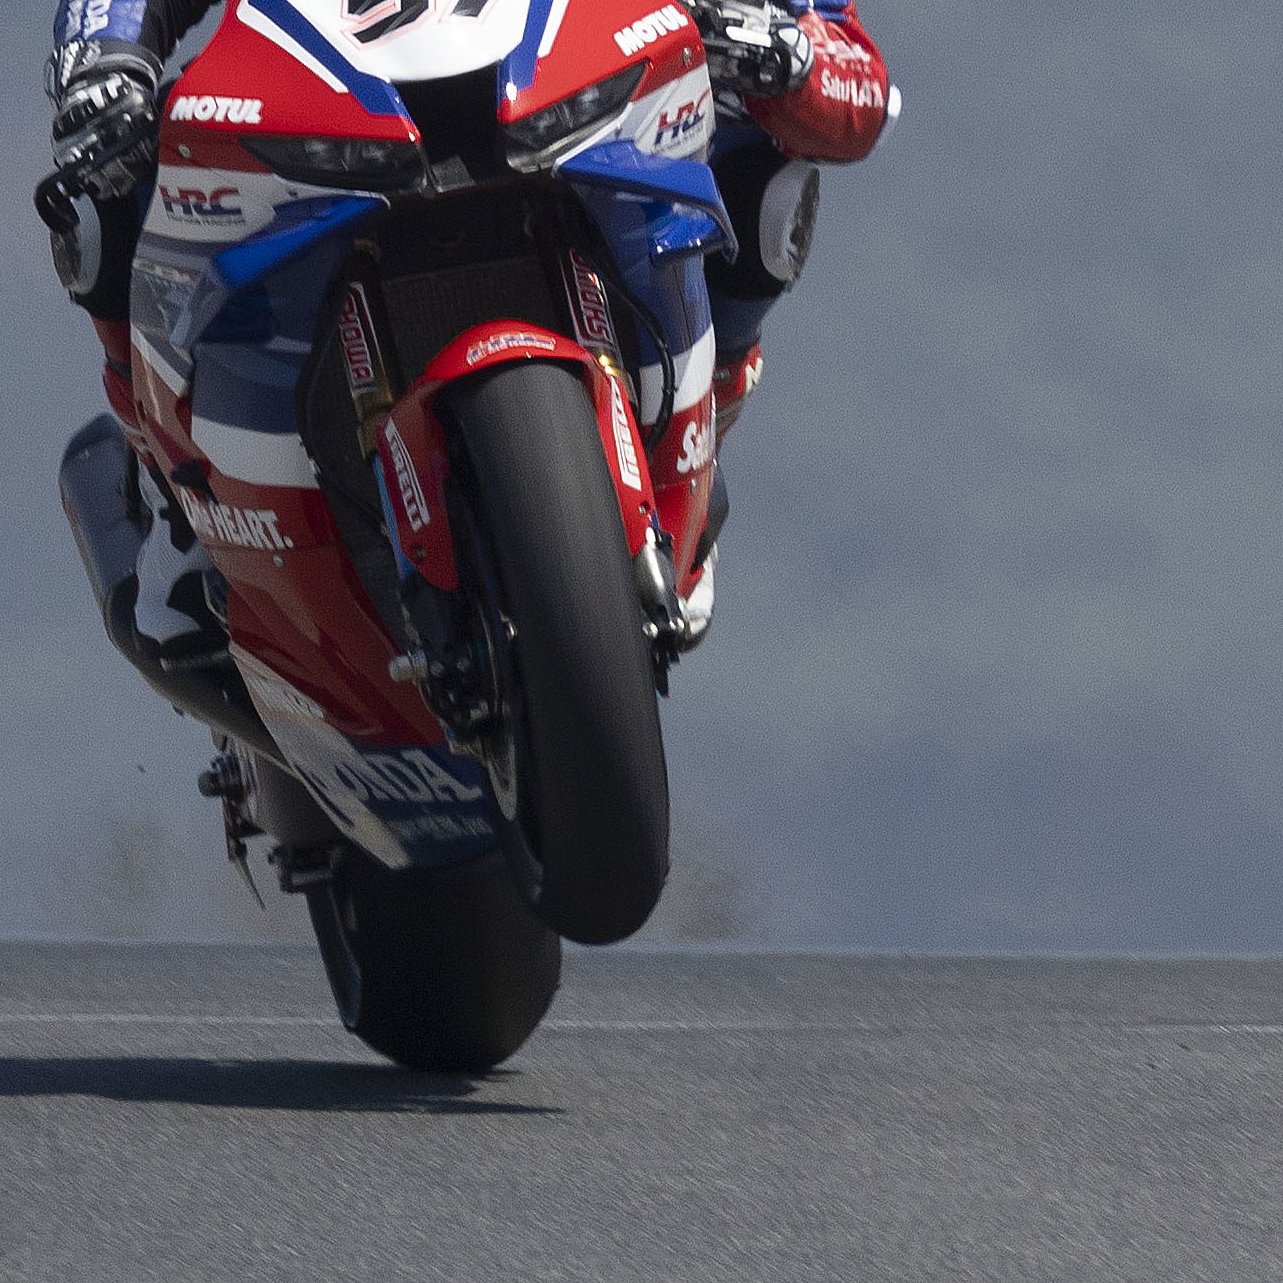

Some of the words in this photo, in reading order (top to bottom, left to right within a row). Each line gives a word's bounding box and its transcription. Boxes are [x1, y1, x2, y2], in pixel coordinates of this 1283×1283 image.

[613, 4, 688, 56] MOTUL
[169, 95, 264, 125] MOTUL
[158, 186, 243, 218] HRC
[384, 417, 432, 532] PIRELLI
[209, 500, 294, 550] HEART.
